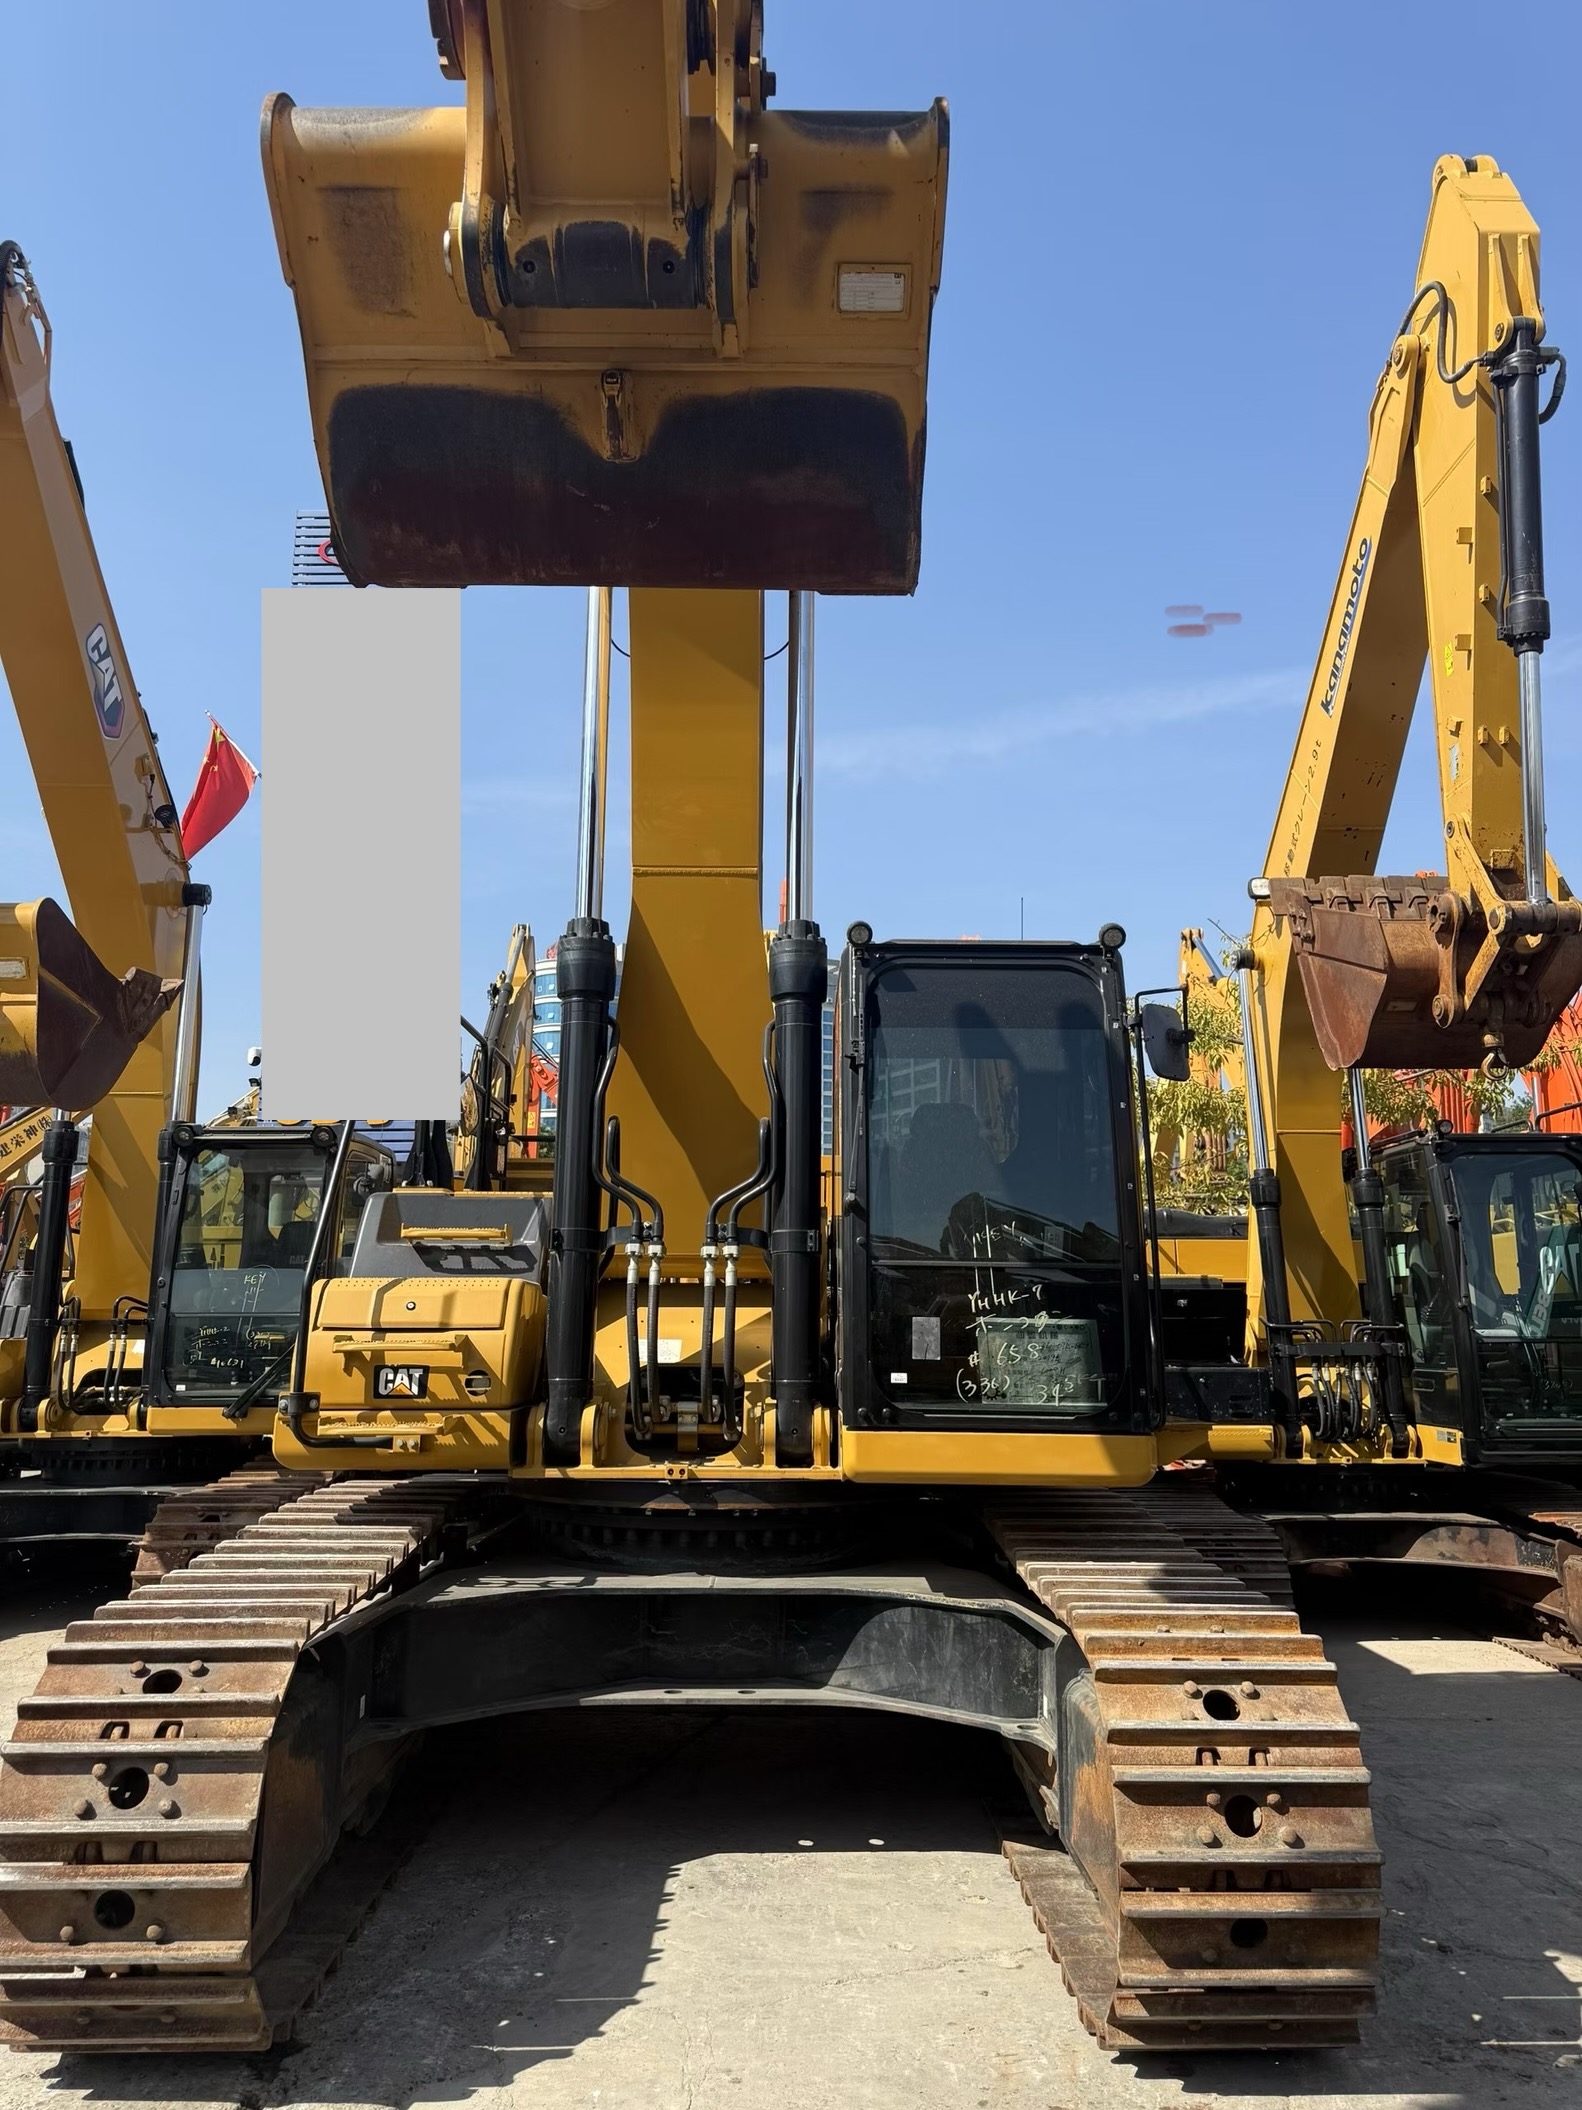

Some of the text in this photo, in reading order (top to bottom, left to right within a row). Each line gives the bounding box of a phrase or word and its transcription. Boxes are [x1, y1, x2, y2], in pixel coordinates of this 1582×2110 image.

[86, 623, 123, 713] CAT
[1321, 537, 1368, 714] kanamoto
[378, 1367, 424, 1396] CAT
